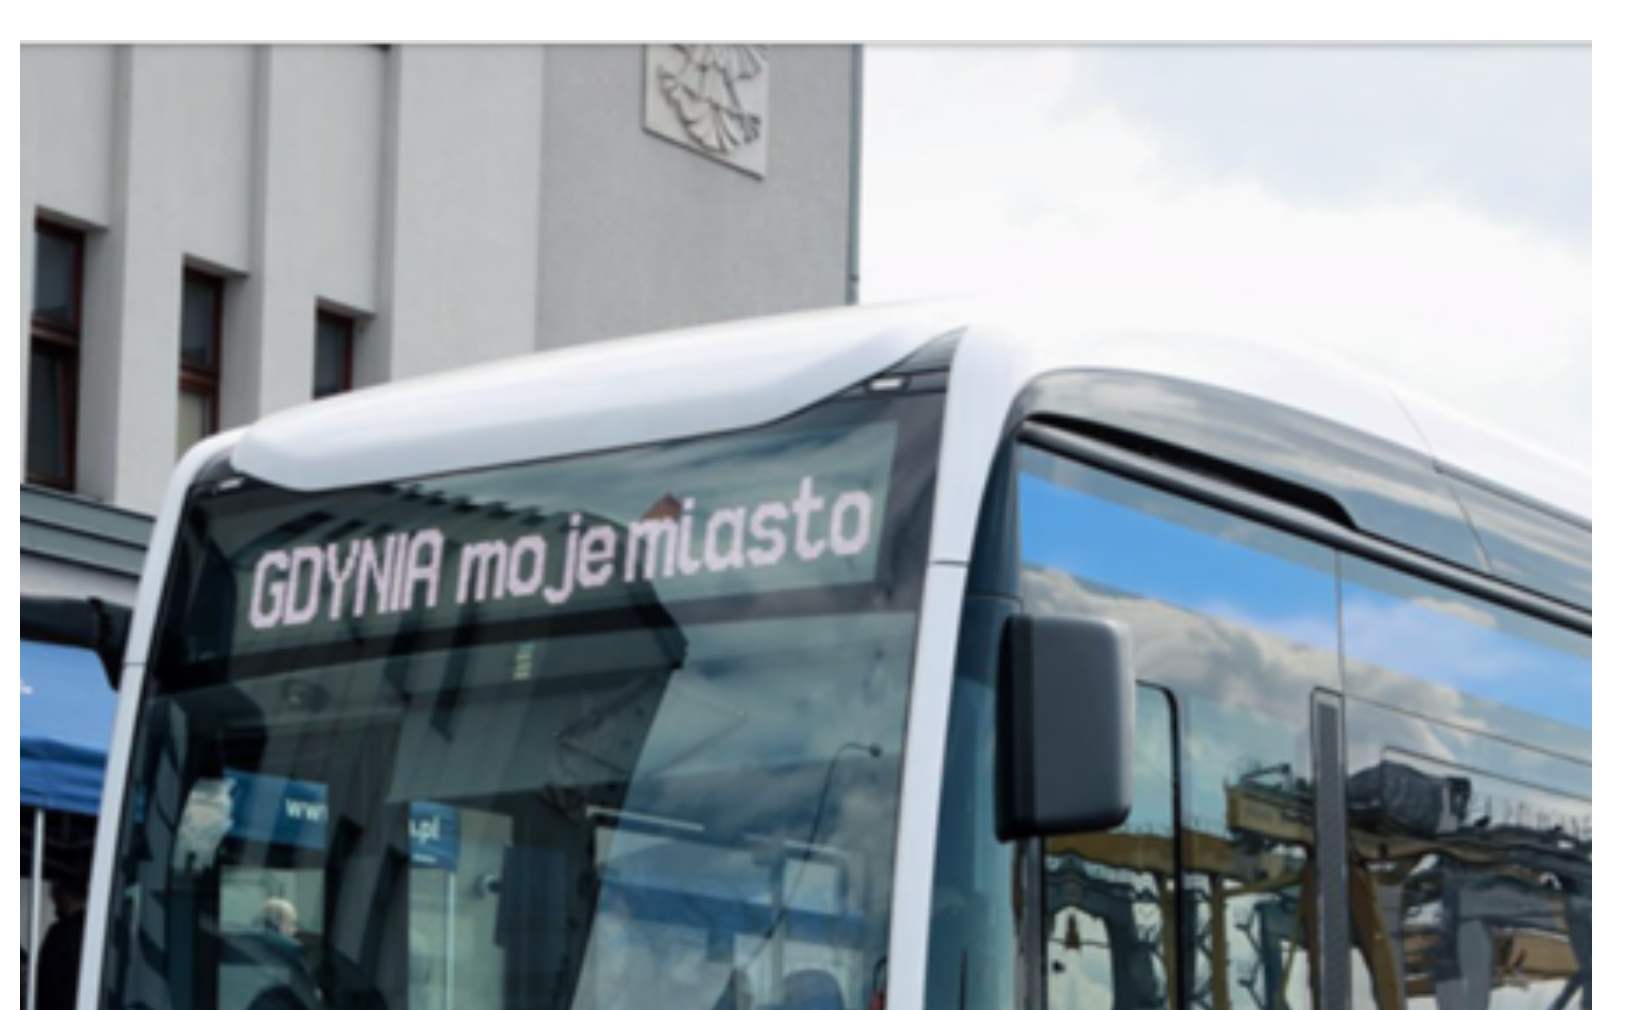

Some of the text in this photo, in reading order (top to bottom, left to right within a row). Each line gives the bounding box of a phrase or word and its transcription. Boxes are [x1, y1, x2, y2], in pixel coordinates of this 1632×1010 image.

[250, 476, 873, 629] GDYNIA moje miasto
